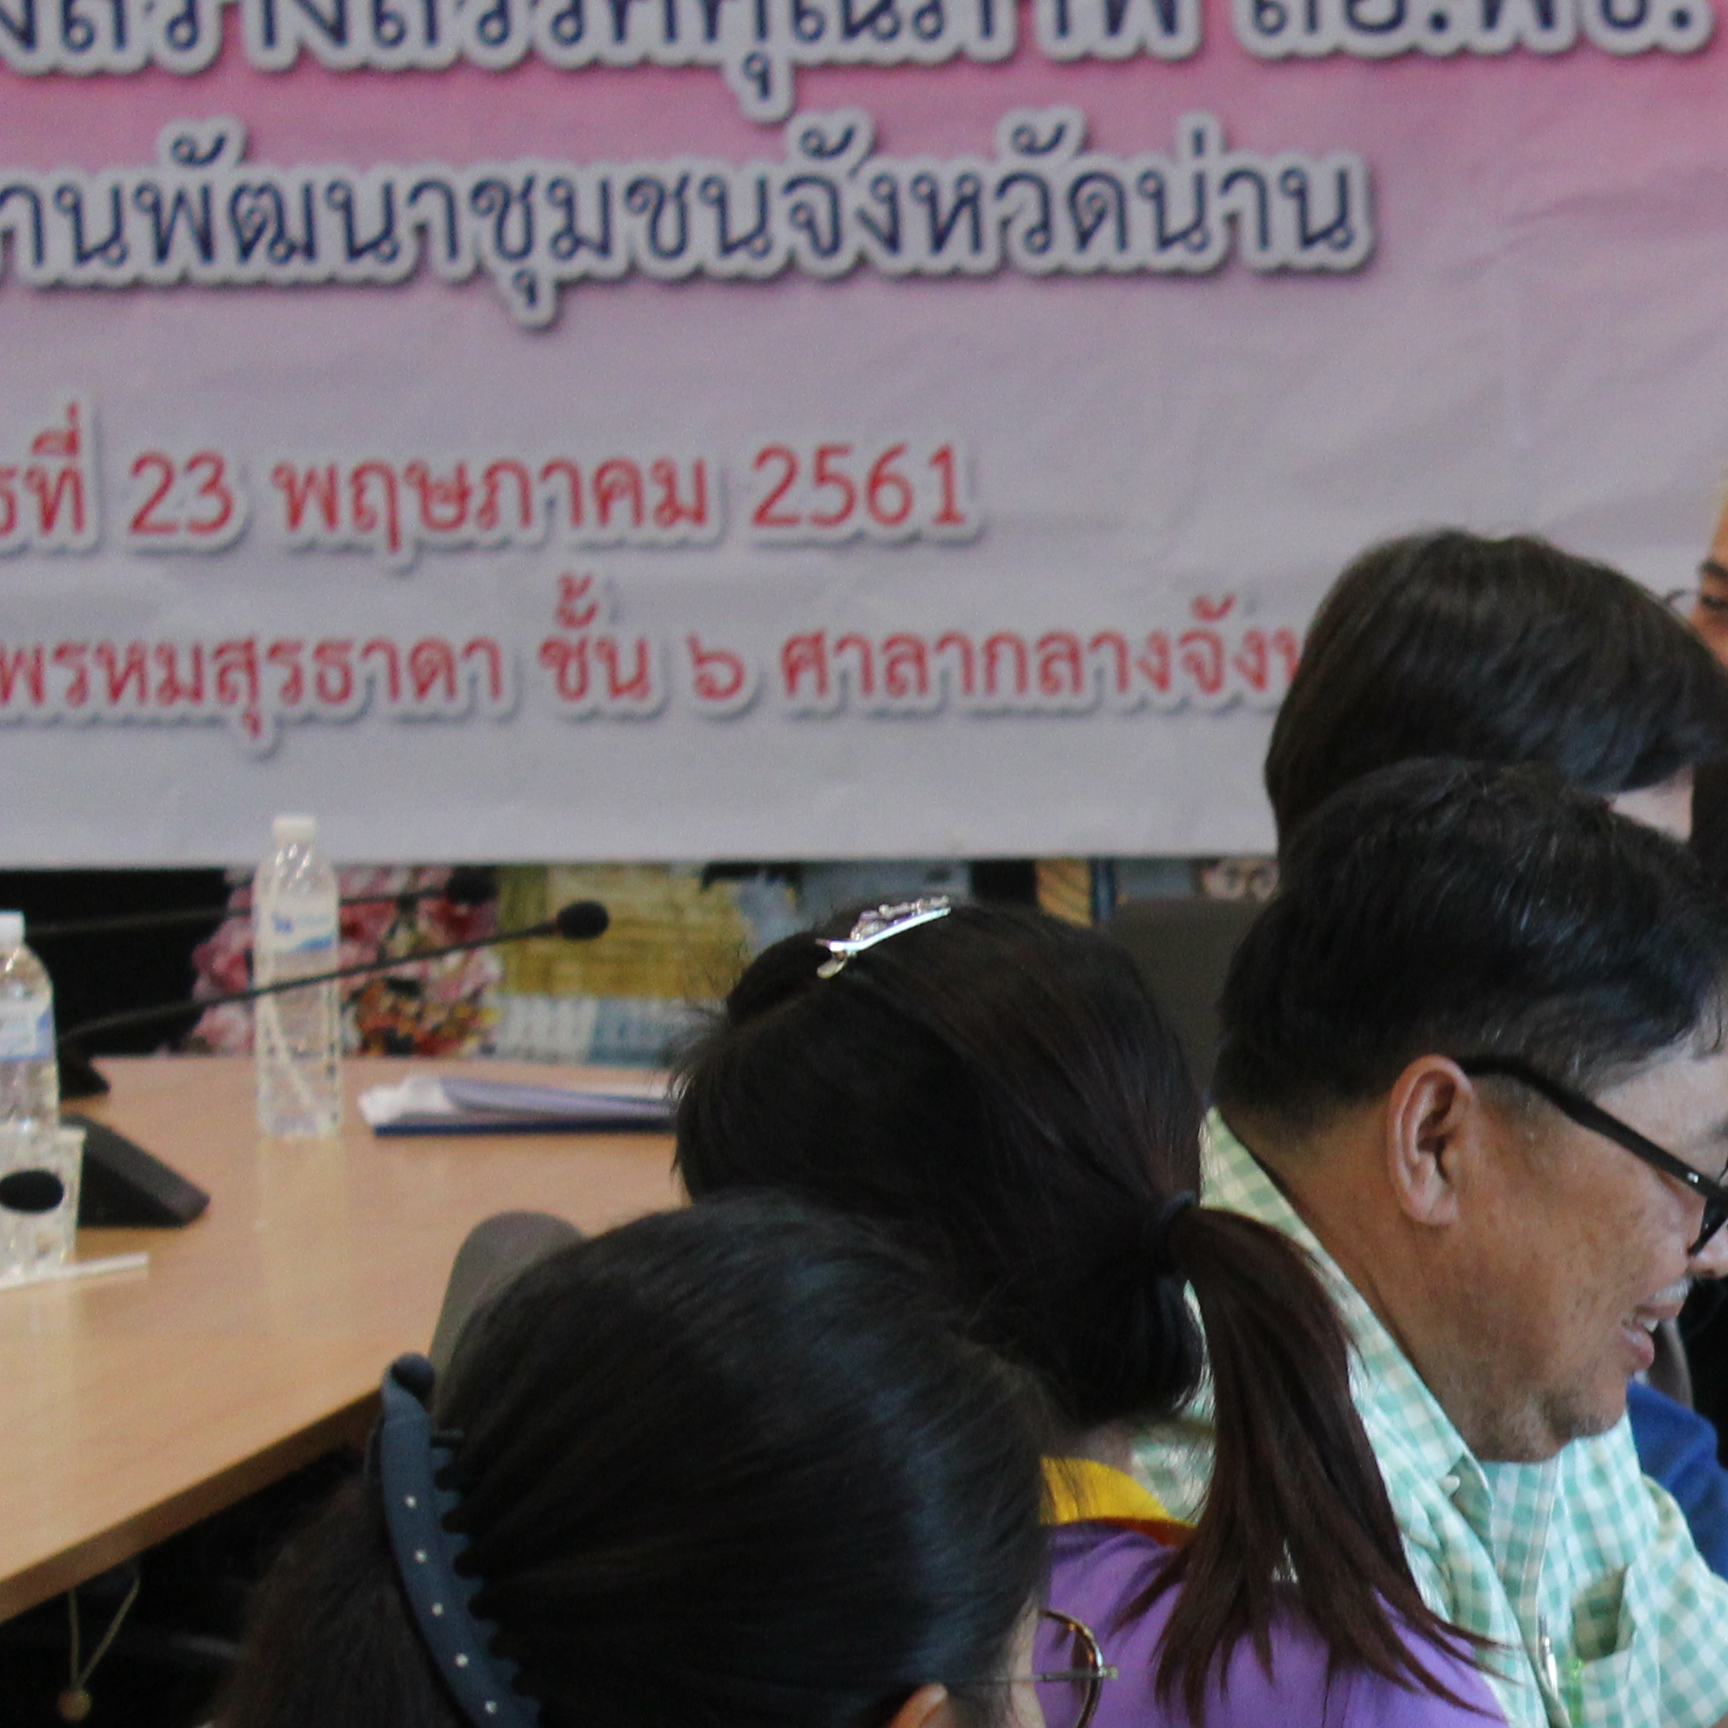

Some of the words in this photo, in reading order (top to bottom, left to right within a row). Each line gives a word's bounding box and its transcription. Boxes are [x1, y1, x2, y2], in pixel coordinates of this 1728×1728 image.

[129, 450, 236, 536] 23
[270, 455, 708, 555] พฤษภาคม
[750, 443, 967, 529] 2561
[538, 571, 652, 702] ชั้น
[687, 632, 746, 703] ๖
